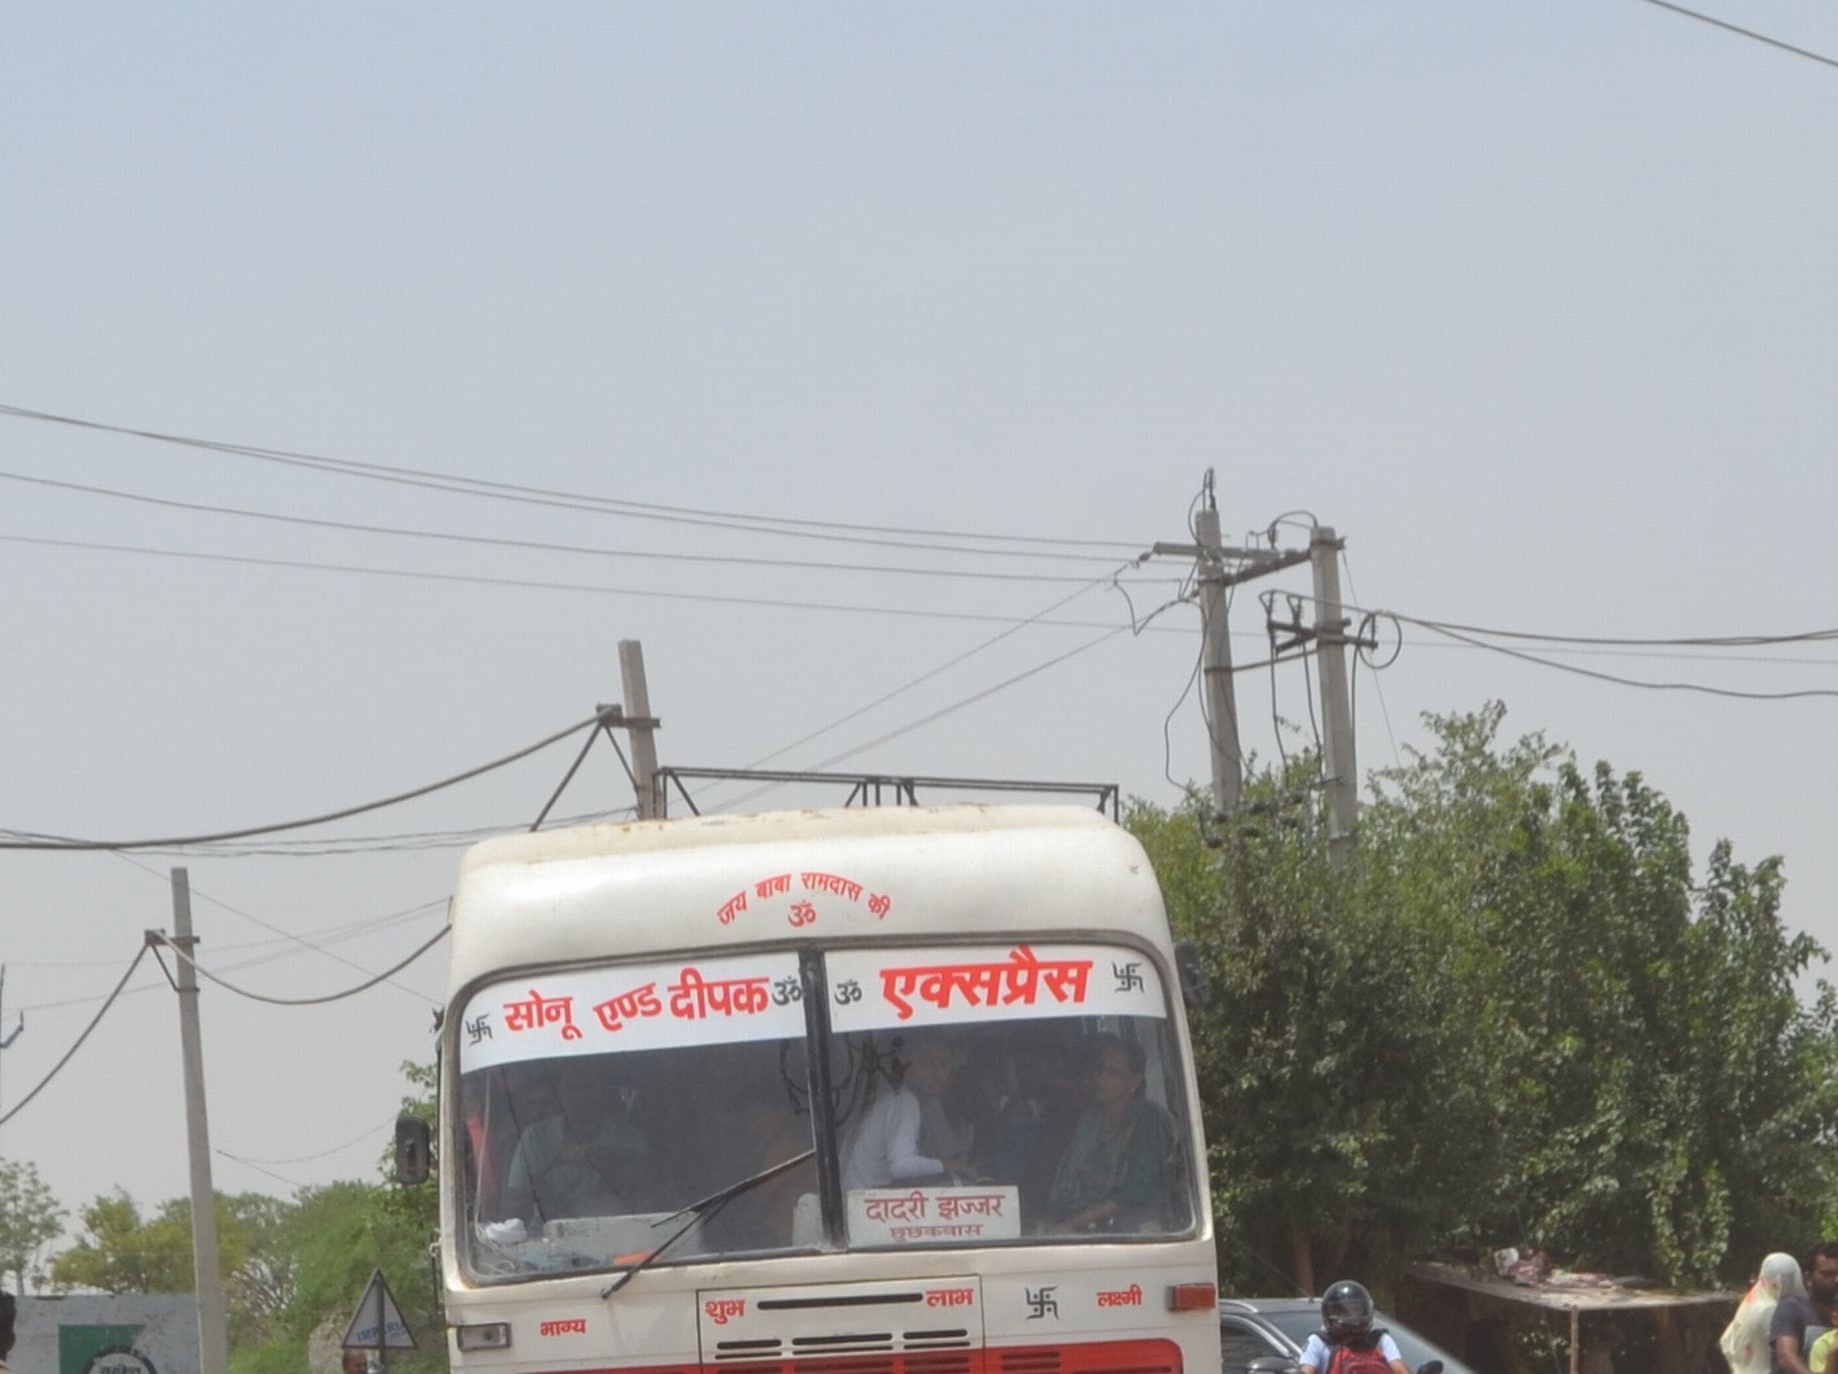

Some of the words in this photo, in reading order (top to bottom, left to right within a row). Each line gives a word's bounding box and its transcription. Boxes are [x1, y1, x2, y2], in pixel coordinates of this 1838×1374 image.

[716, 890, 748, 925] जय
[754, 873, 793, 899] बाबा
[800, 872, 864, 902] रामदास
[867, 892, 891, 920] की
[879, 944, 1094, 1021] एक्सप्रैस
[503, 989, 583, 1041] सोनू
[593, 982, 663, 1032] एण्ड
[667, 967, 770, 1020] दीपक
[864, 1190, 930, 1223] दादरी
[935, 1194, 1006, 1220] झज्जर
[705, 1299, 746, 1325] शुभ
[925, 1288, 974, 1308] लाभ
[1096, 1283, 1143, 1308] लक्ष्मी
[540, 1319, 587, 1337] भाग्य
